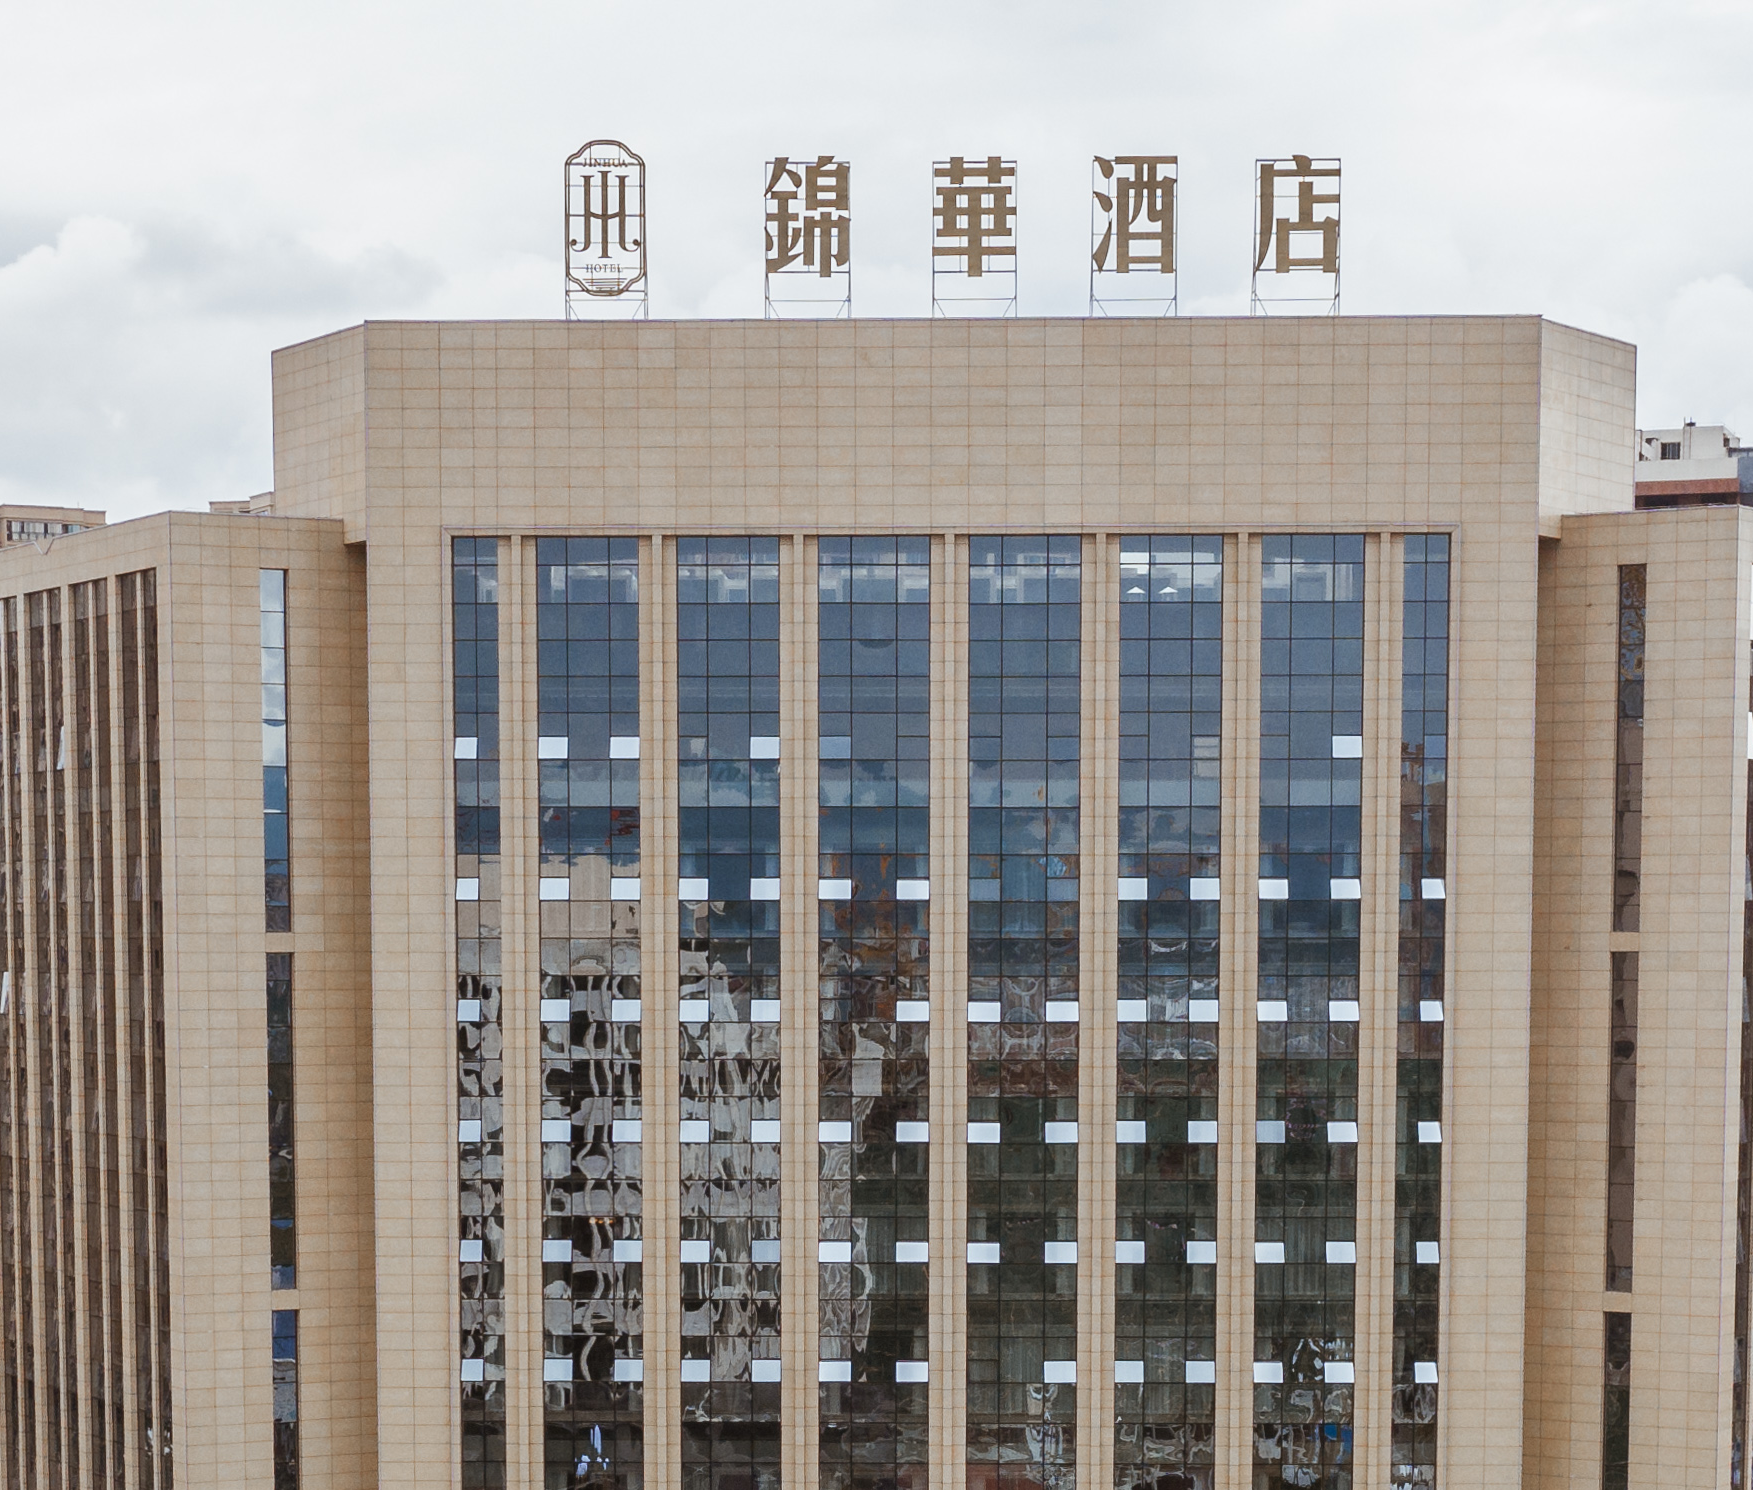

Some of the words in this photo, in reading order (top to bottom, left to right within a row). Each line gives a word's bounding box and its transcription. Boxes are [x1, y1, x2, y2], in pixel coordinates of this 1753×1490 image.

[764, 155, 1342, 278] 錦華酒店
[585, 263, 623, 274] HOTEL
